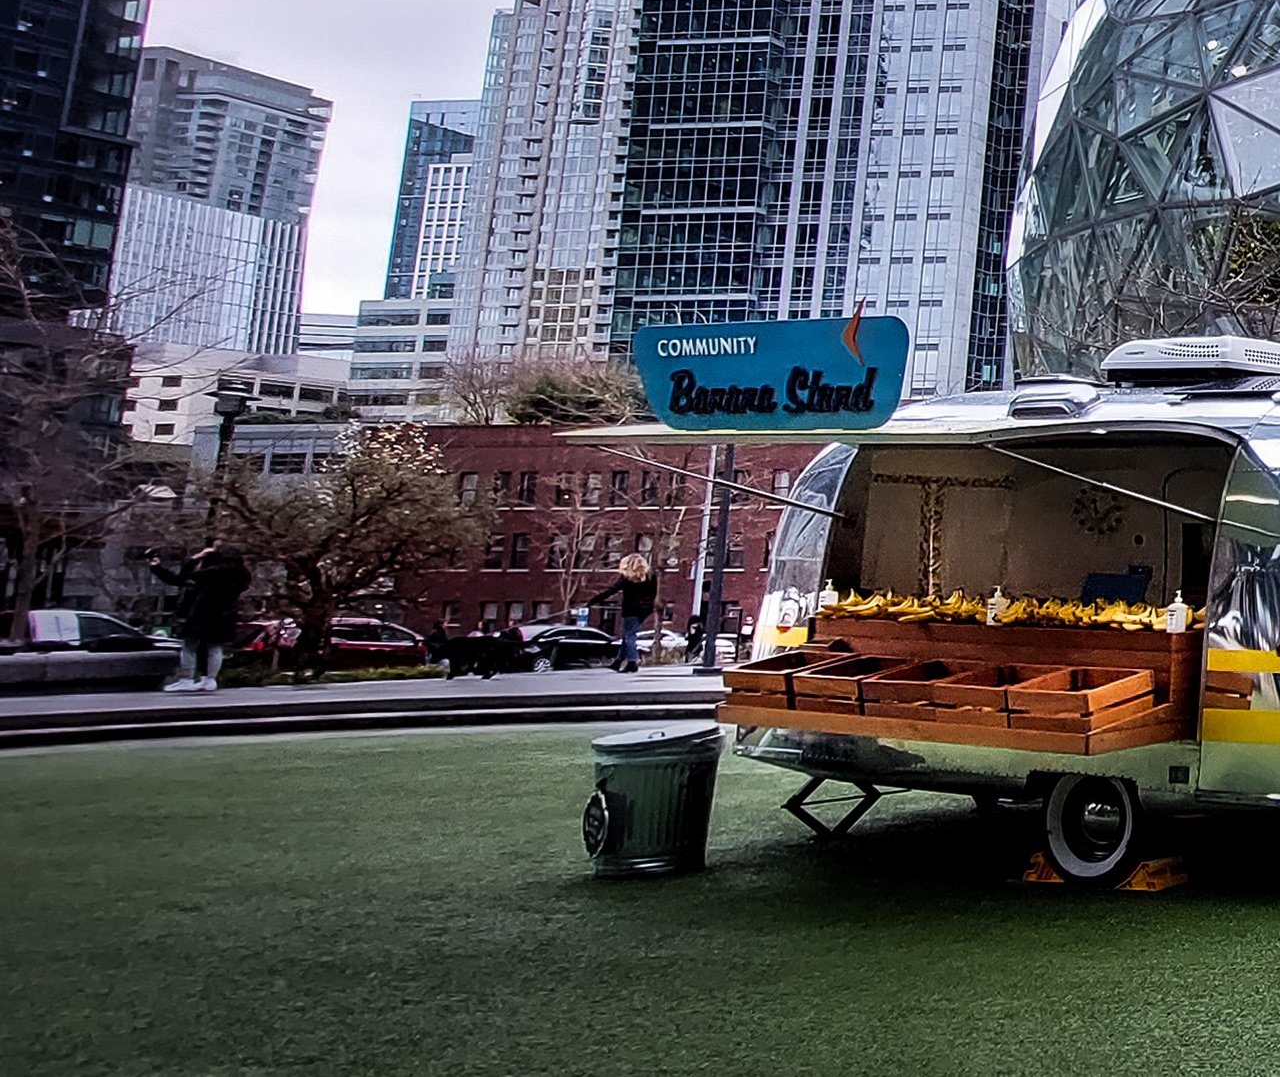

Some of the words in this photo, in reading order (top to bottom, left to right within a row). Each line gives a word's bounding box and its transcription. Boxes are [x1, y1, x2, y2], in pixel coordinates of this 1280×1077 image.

[657, 336, 757, 357] COMMUNITY
[668, 368, 778, 415] Banana
[782, 365, 879, 415] Stand
